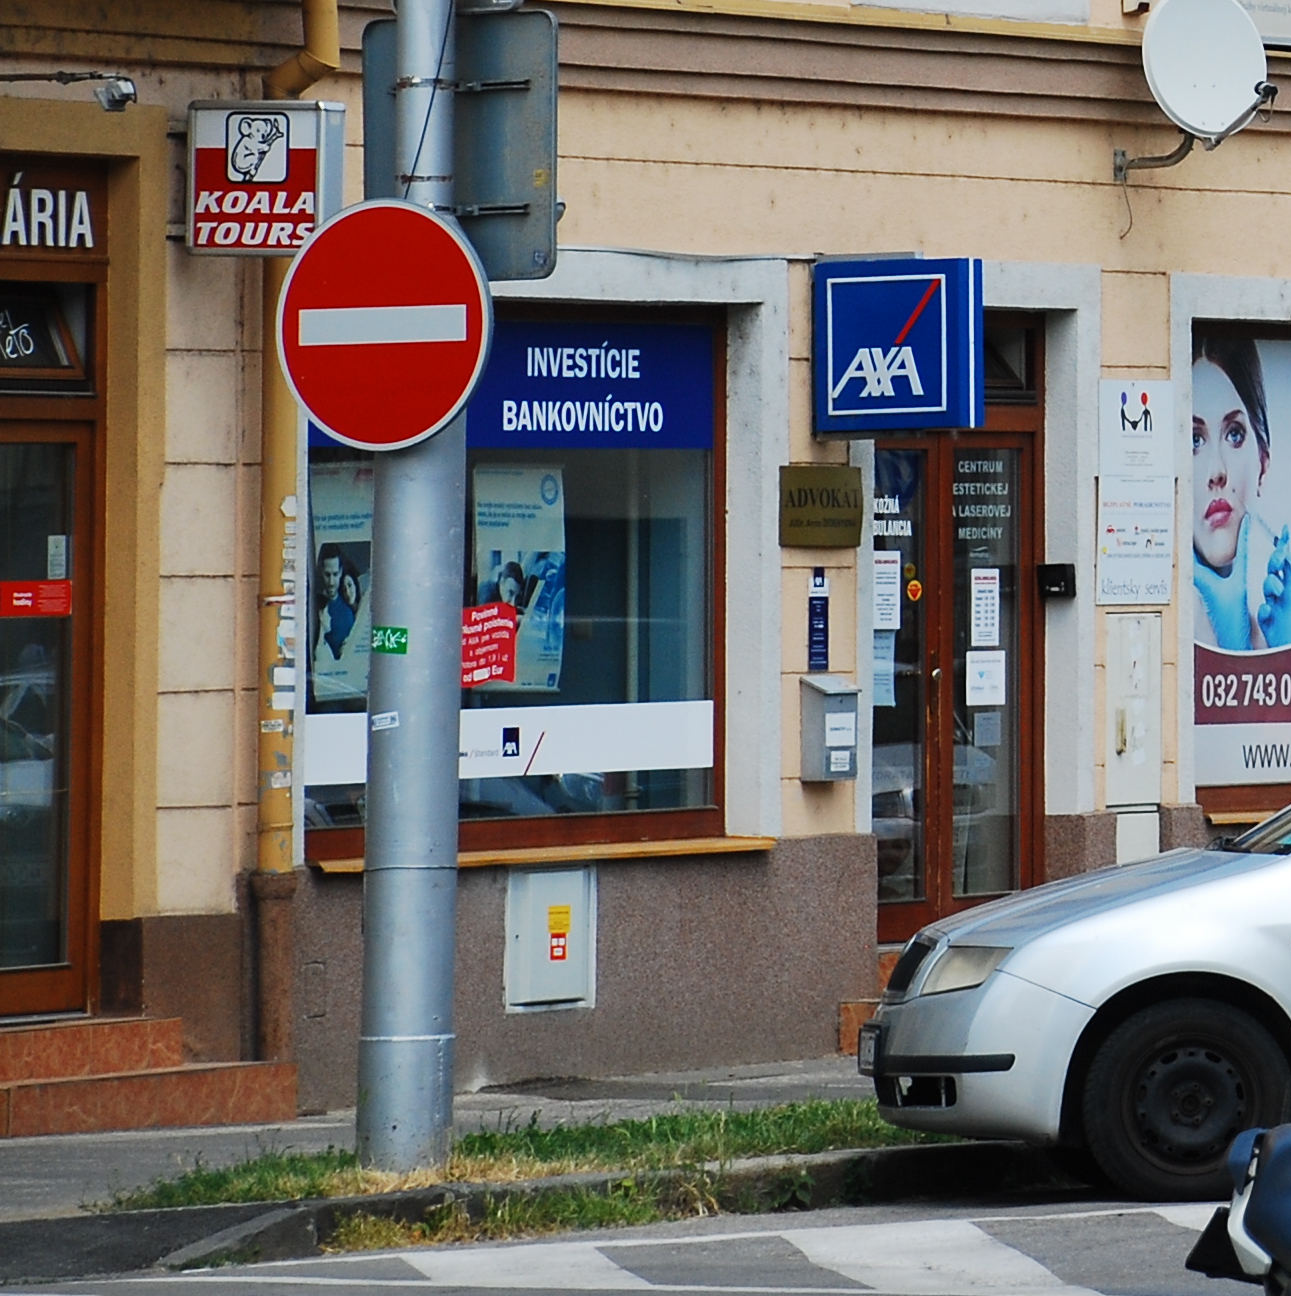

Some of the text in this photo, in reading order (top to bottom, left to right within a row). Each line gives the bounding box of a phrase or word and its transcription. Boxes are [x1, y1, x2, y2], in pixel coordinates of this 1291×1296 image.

[1, 171, 94, 249] ÁRIA
[195, 190, 315, 215] KOALA
[195, 221, 315, 246] TOURS
[527, 340, 641, 379] INVESTÍCIE
[831, 346, 925, 398] AXA
[502, 393, 664, 433] BANKOVNÍCTVO
[958, 460, 1004, 473] CENTRUM
[784, 482, 860, 509] ADVOKÁT
[952, 482, 1009, 495] ESTETICKEJ
[958, 505, 1011, 518] LASEROVEJ
[958, 524, 1004, 540] MEDICÍNY
[1101, 577, 1168, 600] klientsky servis
[1202, 674, 1239, 708] 032
[1241, 673, 1277, 707] 743
